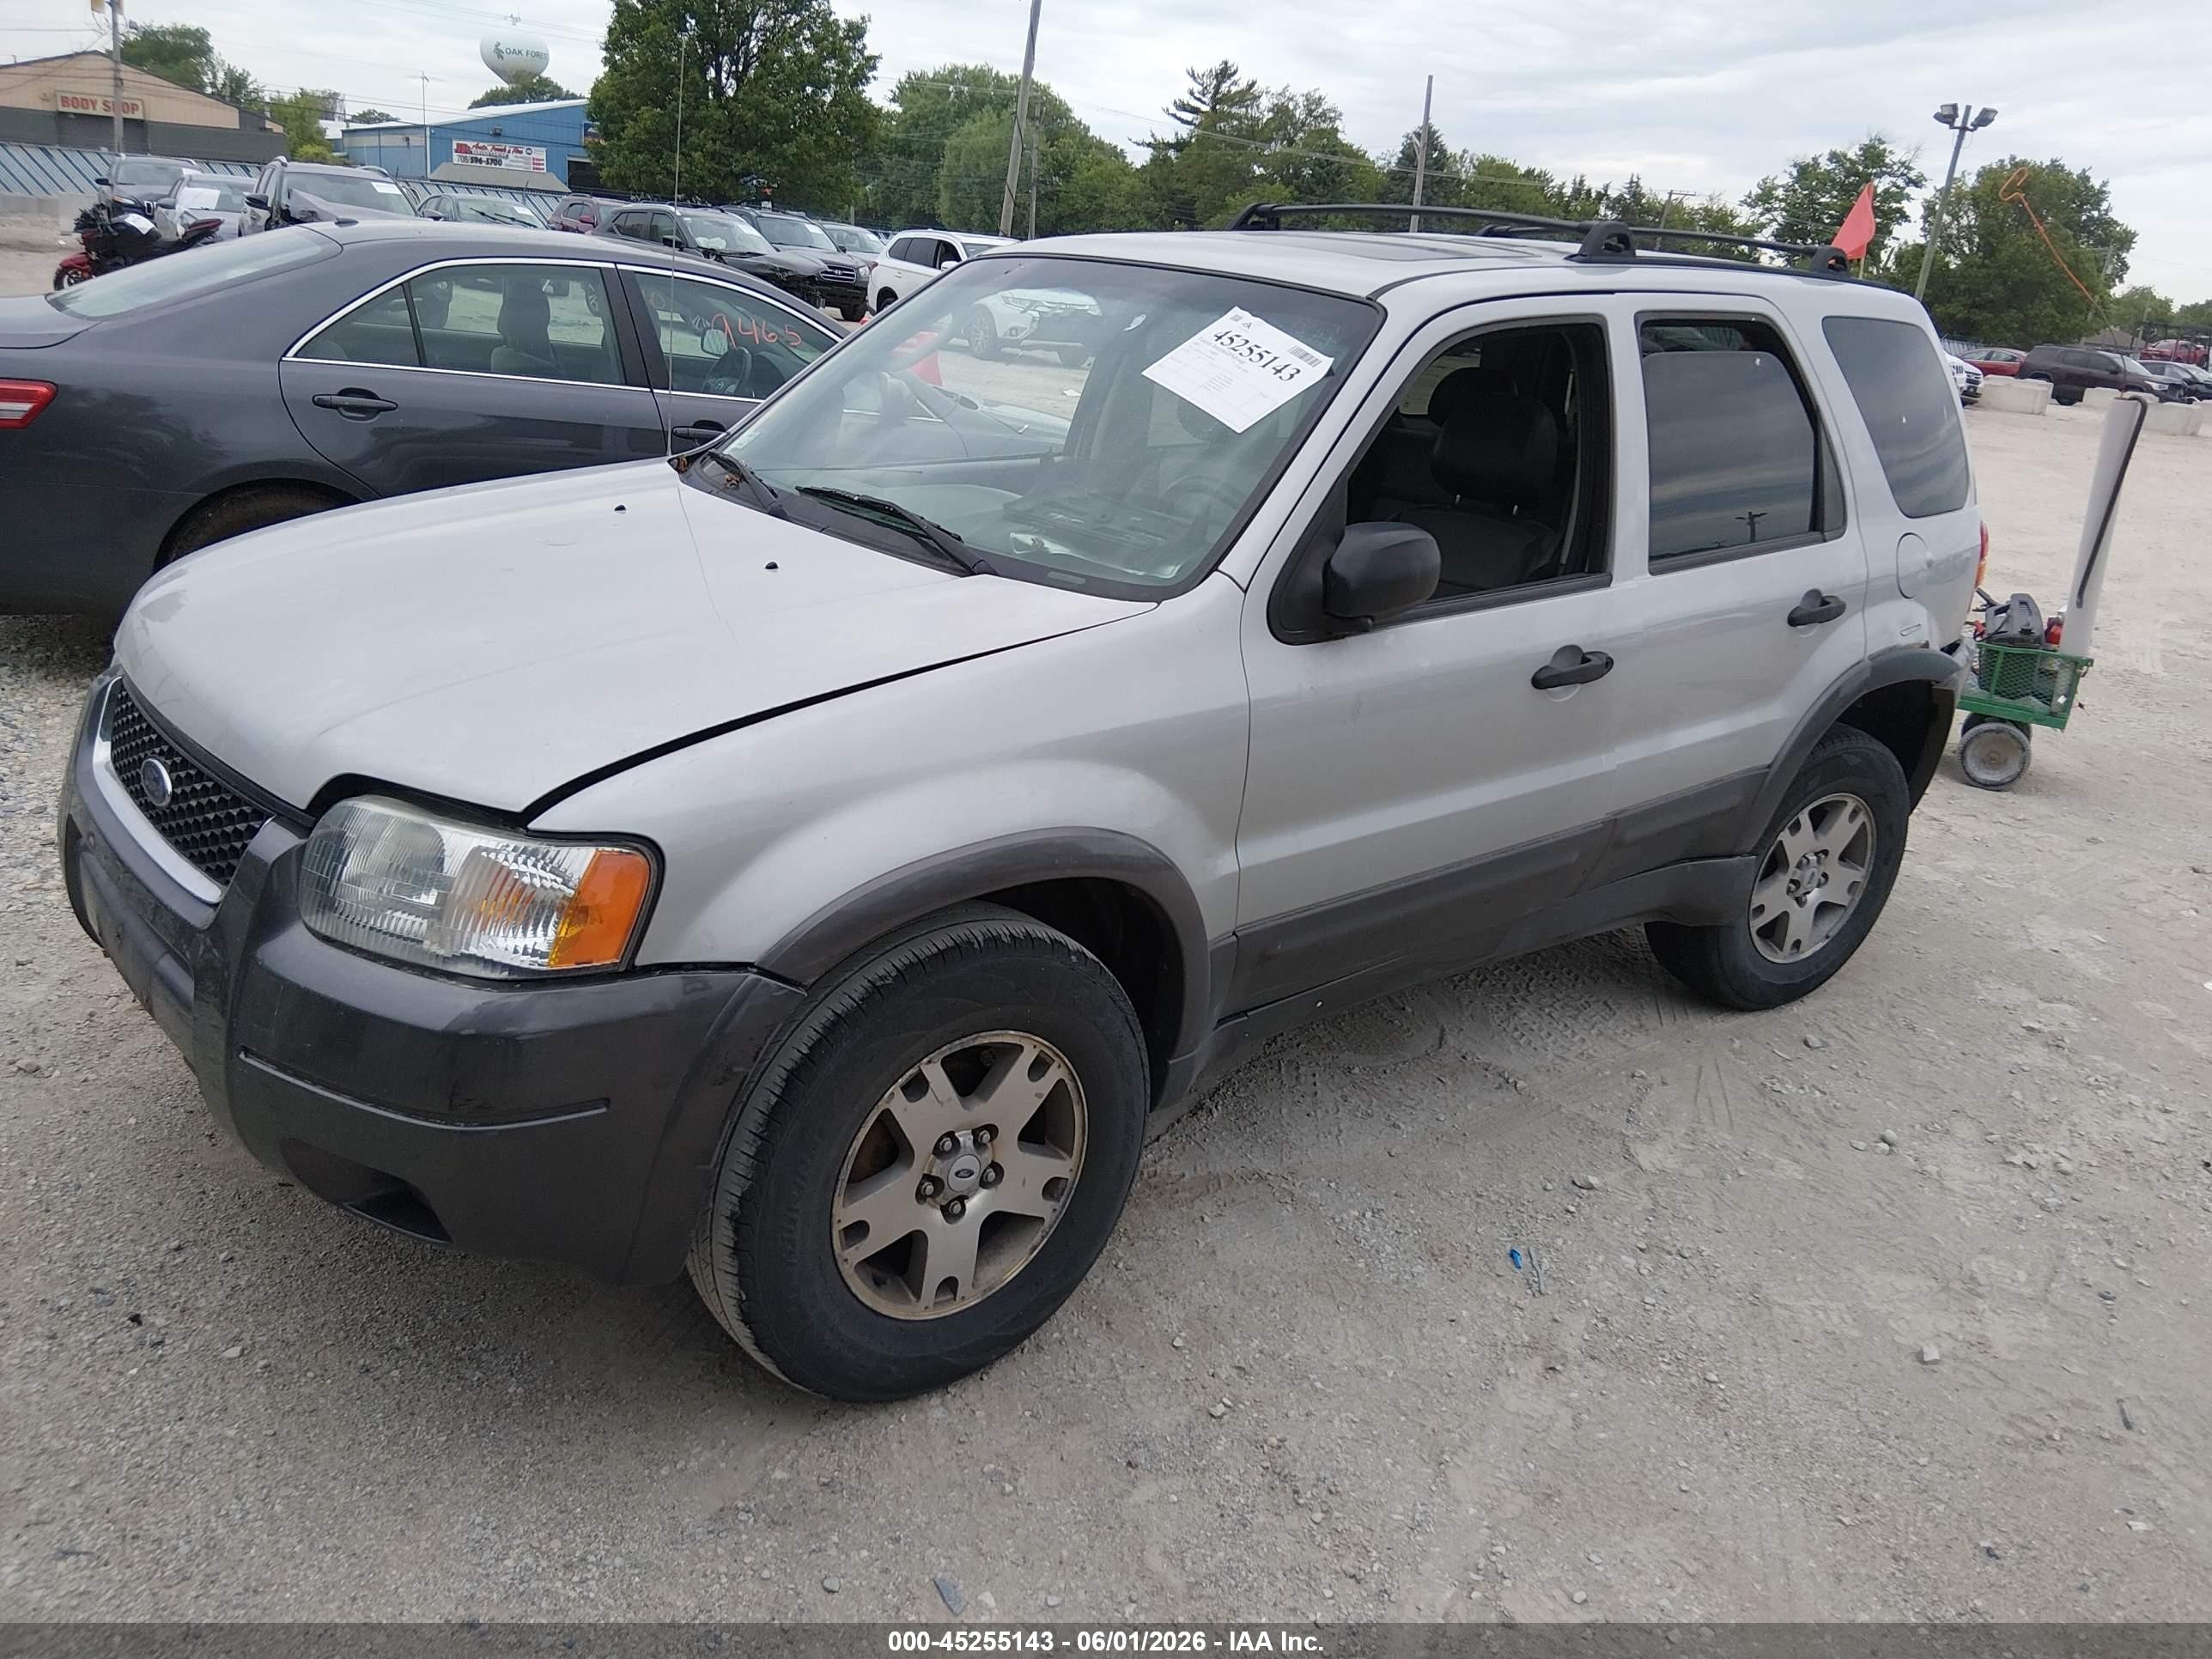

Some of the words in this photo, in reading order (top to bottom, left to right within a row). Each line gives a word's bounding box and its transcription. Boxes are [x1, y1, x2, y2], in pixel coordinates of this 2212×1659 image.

[505, 47, 524, 57] OAK
[60, 95, 98, 111] BODY
[1213, 330, 1301, 382] 45255143
